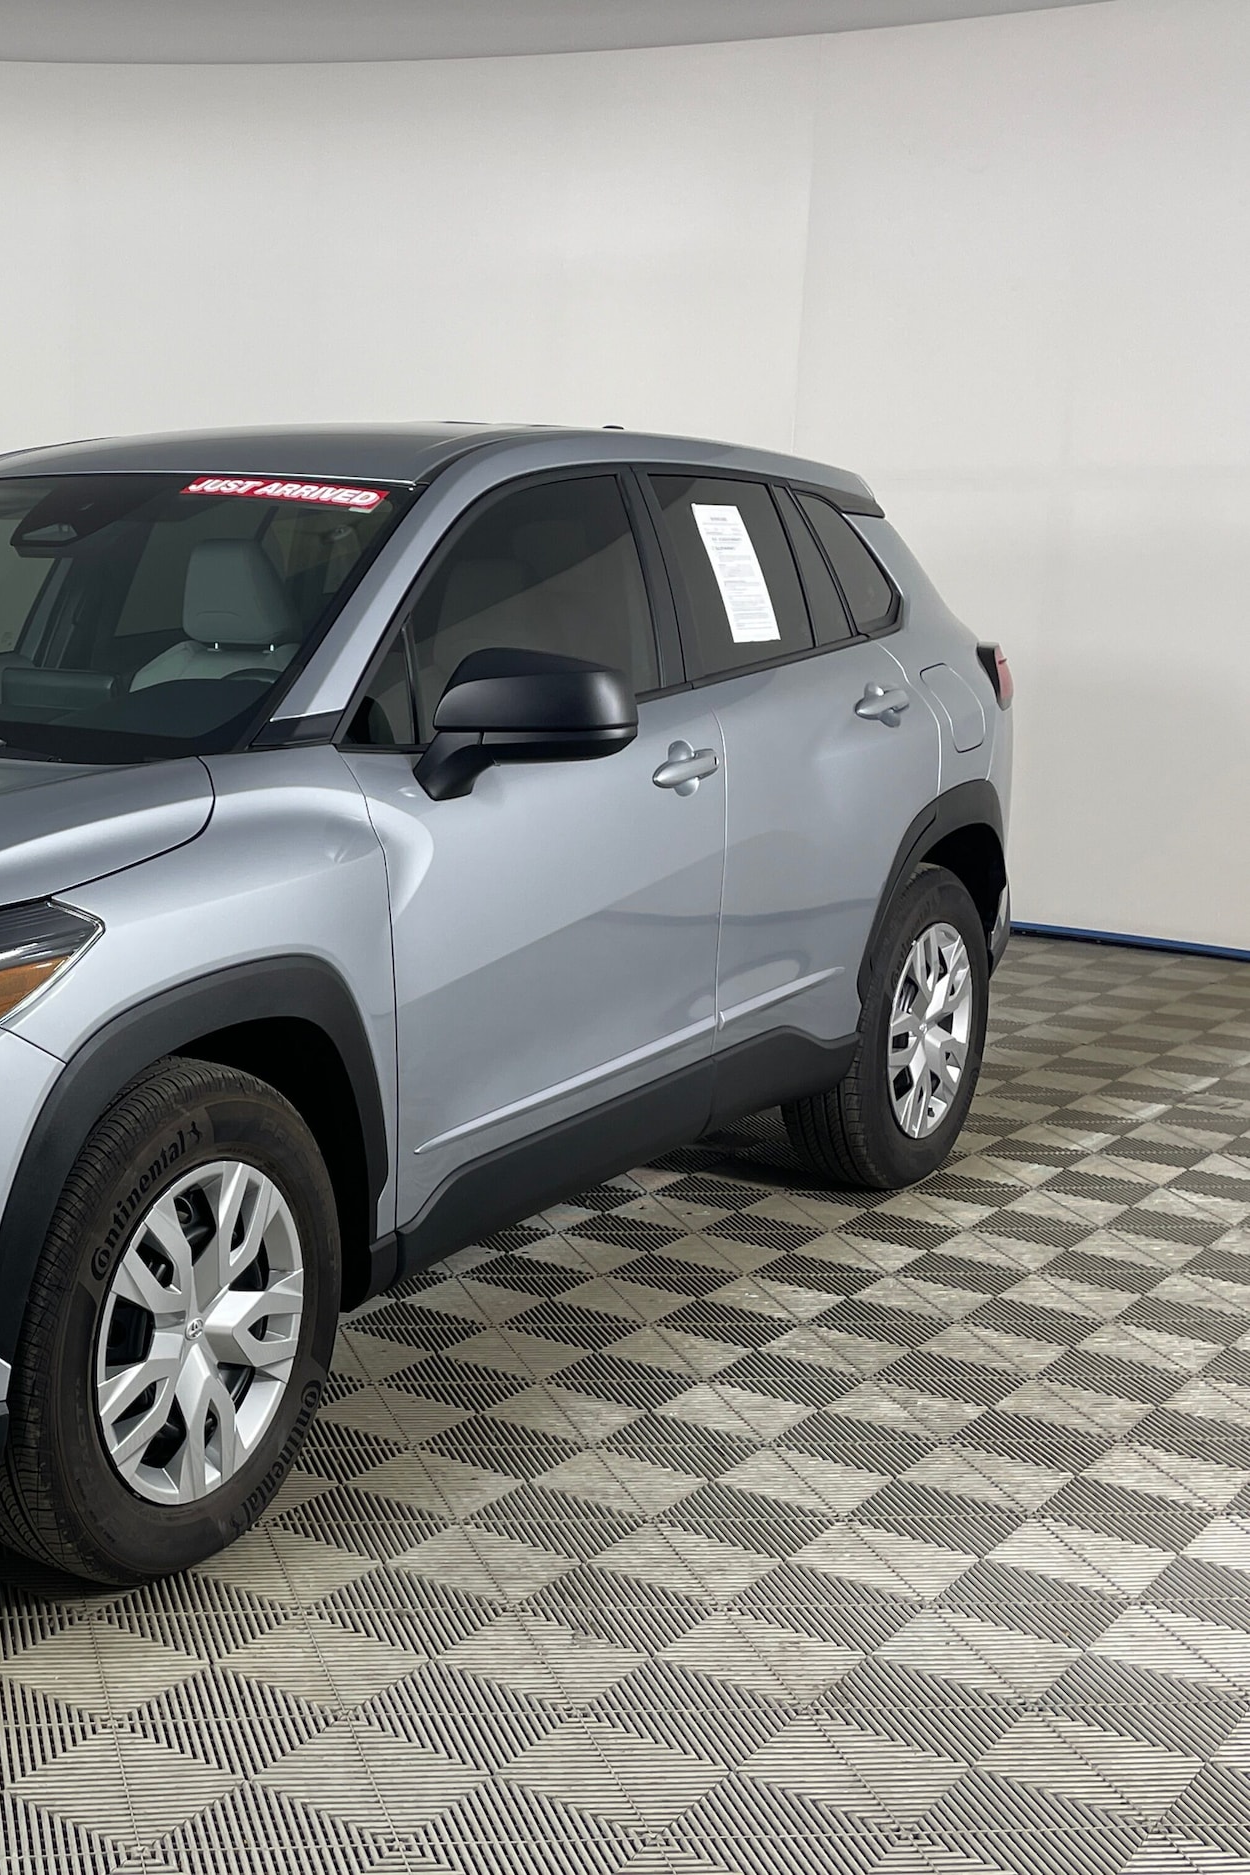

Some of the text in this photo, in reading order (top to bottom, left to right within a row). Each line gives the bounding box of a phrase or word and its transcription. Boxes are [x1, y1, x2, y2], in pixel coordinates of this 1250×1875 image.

[189, 479, 381, 505] JUST ARRIVED
[91, 1130, 186, 1281] Continental
